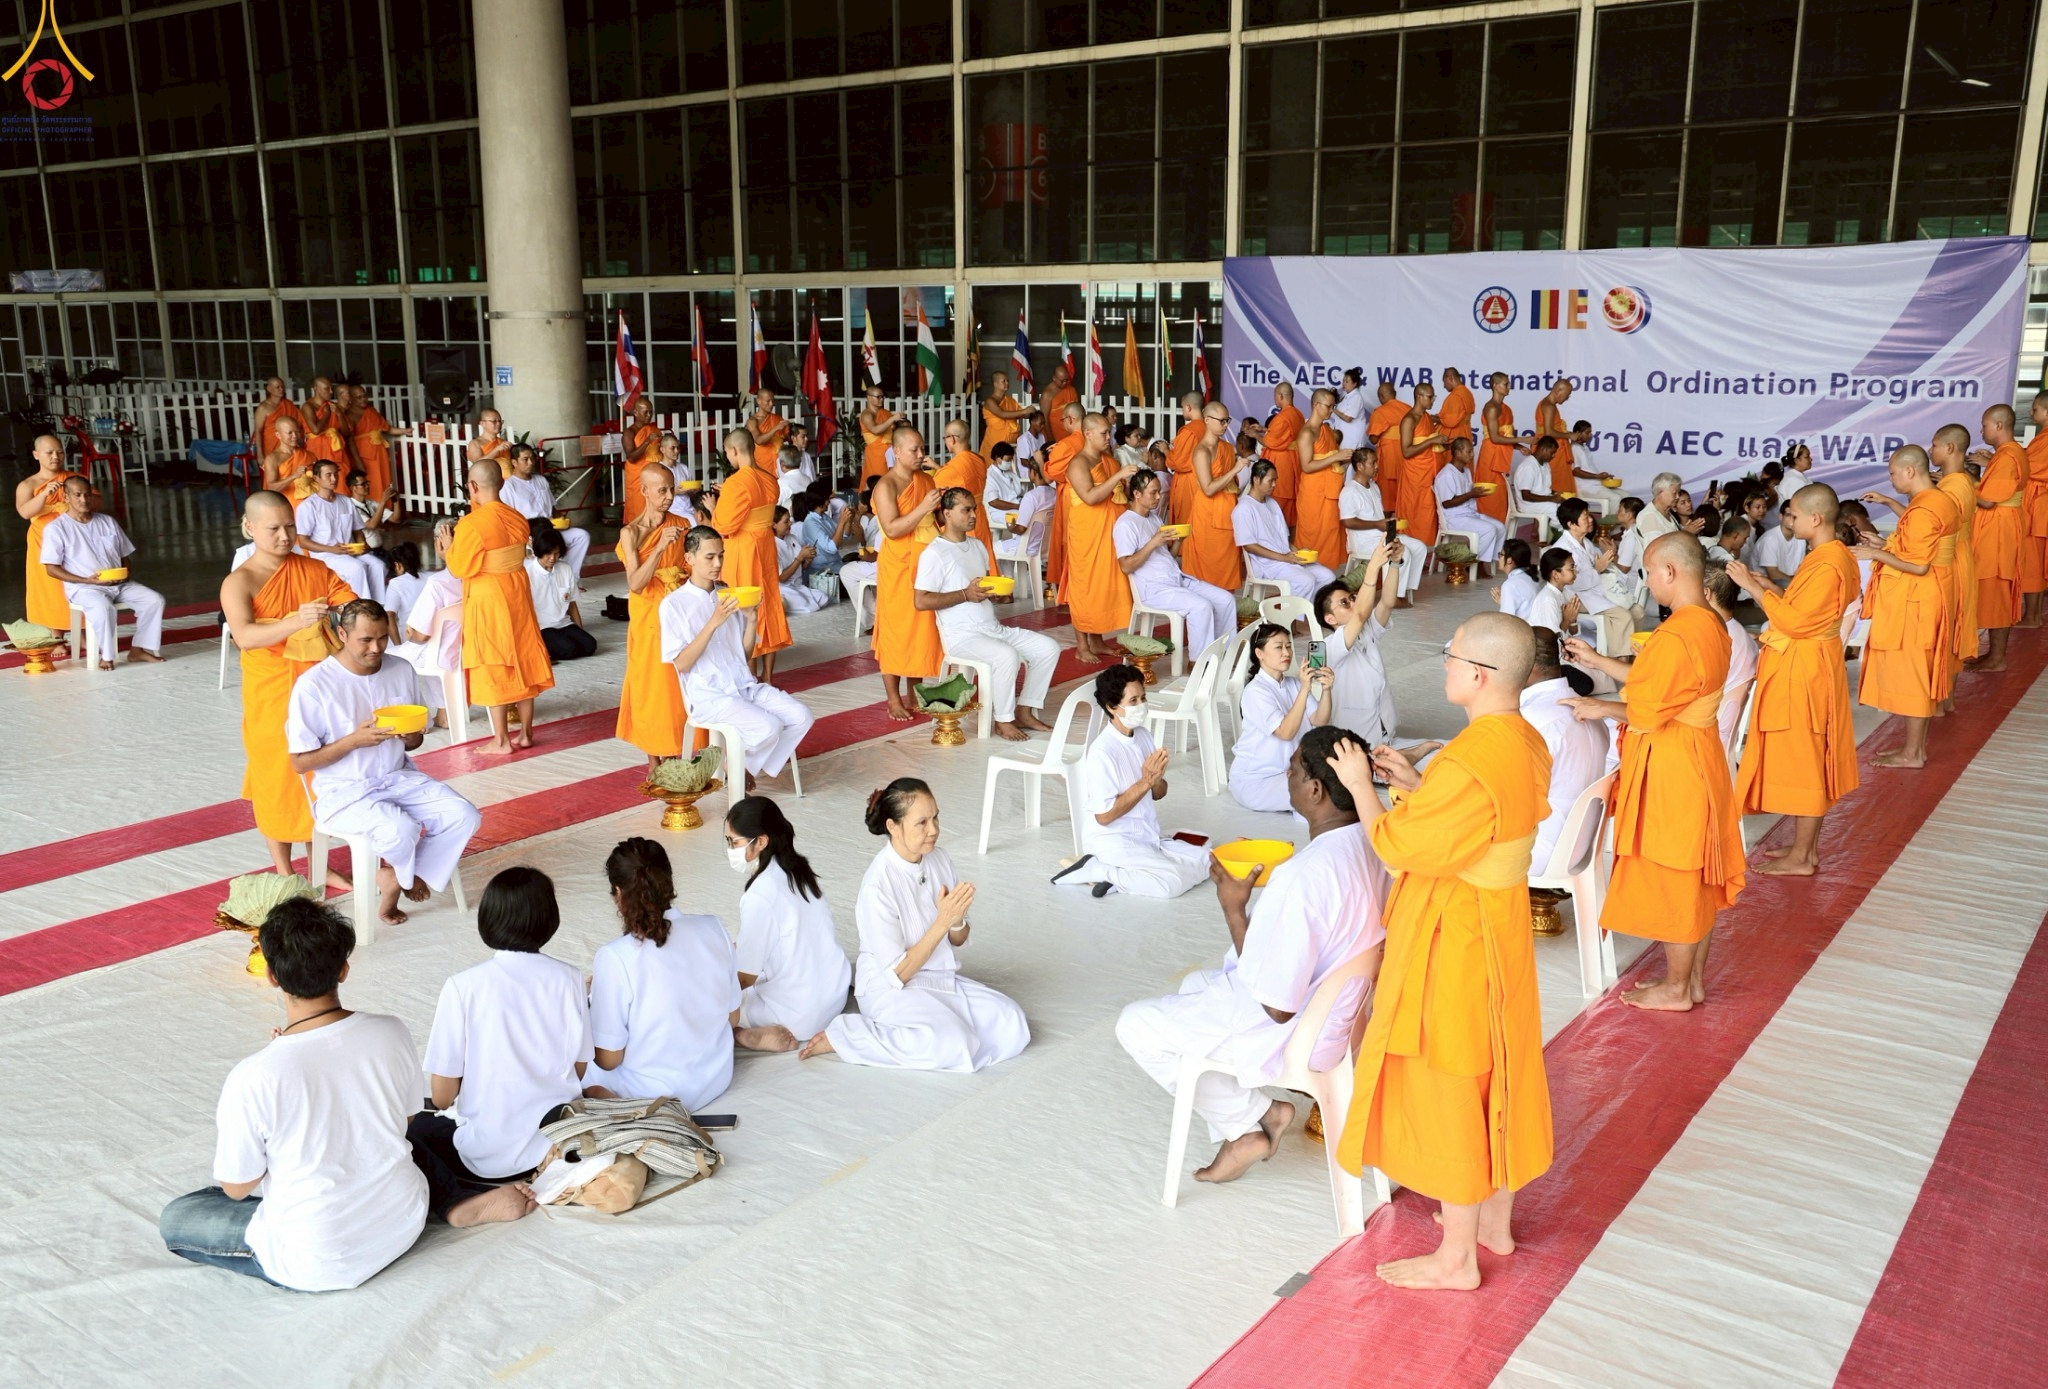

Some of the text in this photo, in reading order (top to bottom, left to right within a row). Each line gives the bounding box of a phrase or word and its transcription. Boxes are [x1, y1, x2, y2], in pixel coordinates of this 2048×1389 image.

[1238, 364, 1280, 385] The
[1295, 365, 1342, 386] AEC
[1377, 366, 1434, 388] WAB
[1647, 370, 1817, 396] Ordination
[1830, 372, 1979, 405] Program
[1655, 430, 1724, 457] AEC
